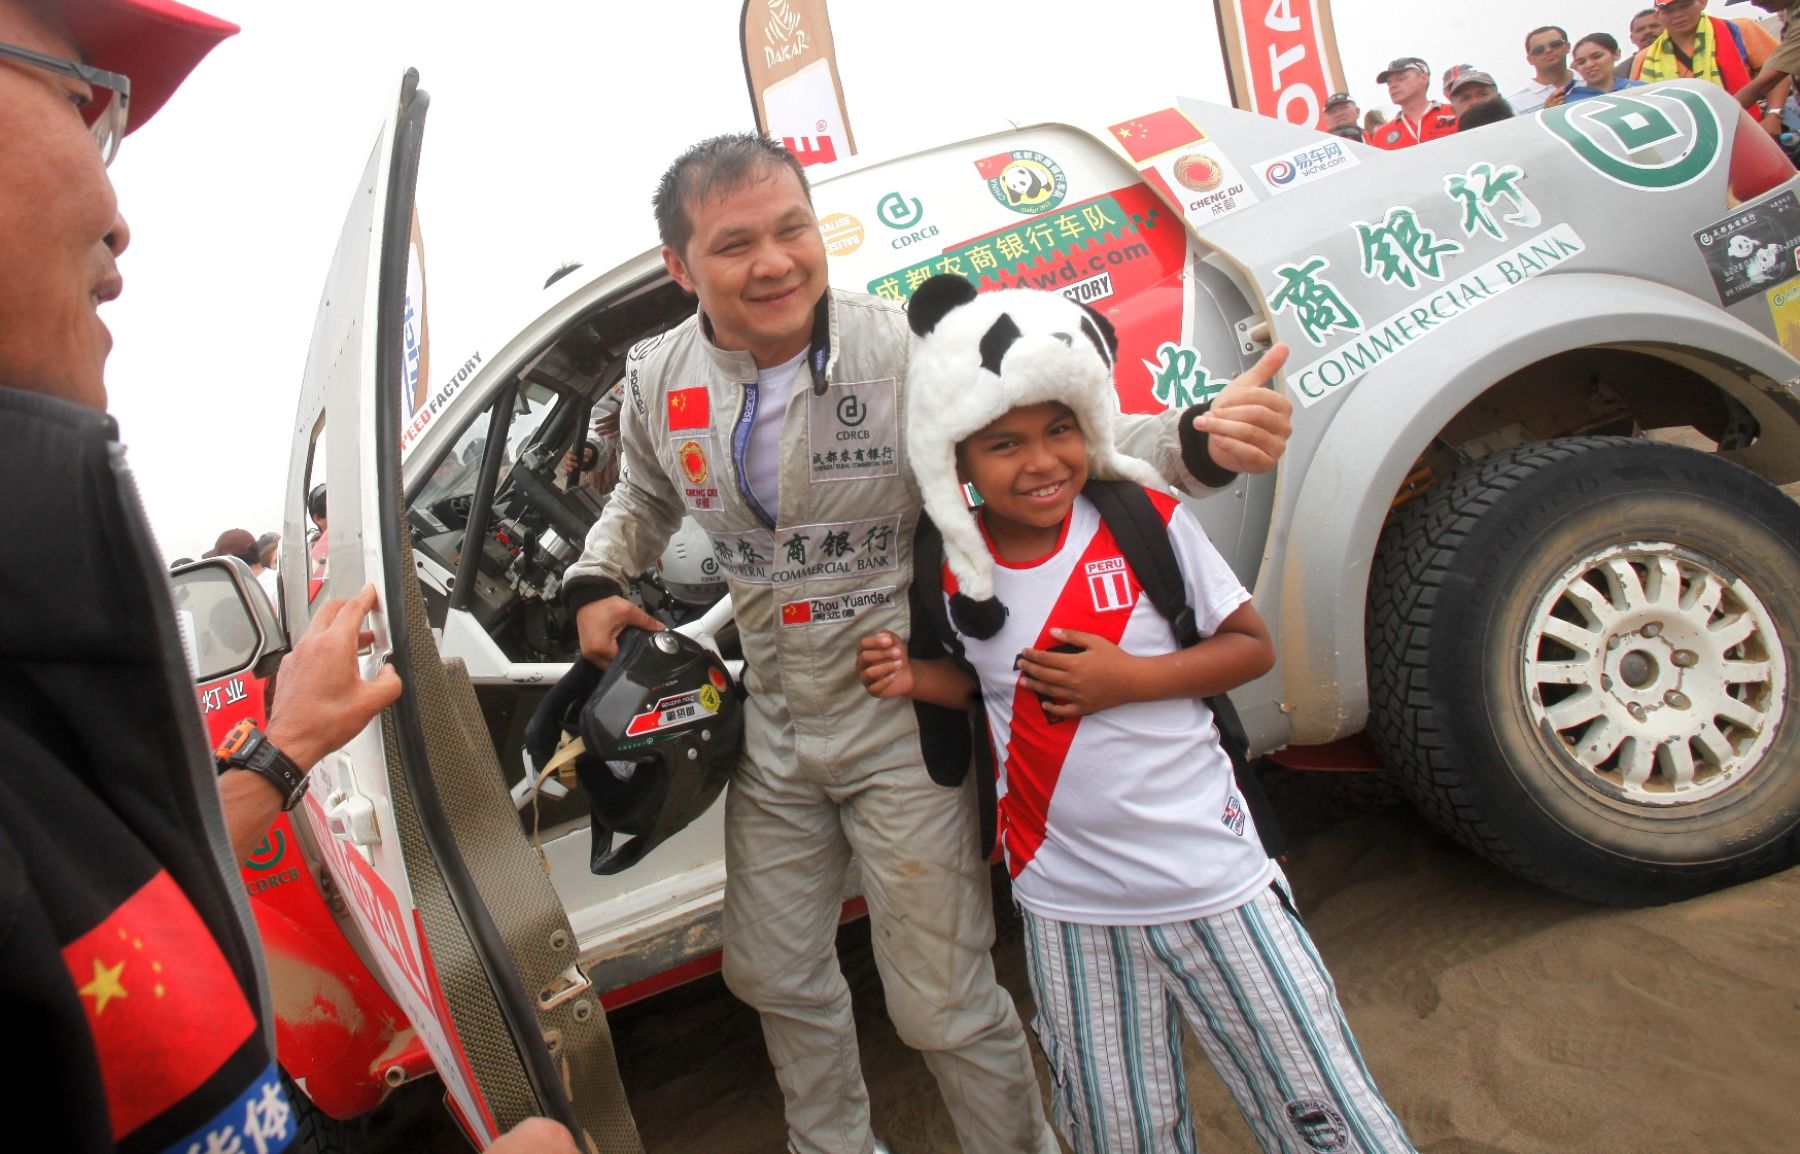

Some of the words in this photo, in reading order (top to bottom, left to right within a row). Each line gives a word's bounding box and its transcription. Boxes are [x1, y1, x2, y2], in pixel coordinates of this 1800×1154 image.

[764, 30, 809, 69] DAKAR
[1293, 142, 1344, 170] 易车网
[1301, 156, 1348, 177] yiche.com
[1189, 190, 1227, 212] CHENG
[1228, 183, 1244, 200] DU
[891, 224, 940, 250] CDRCB
[1001, 242, 1151, 292] 4wd.com
[1298, 275, 1499, 398] COMMERCIAL
[400, 408, 432, 451] PEED
[430, 351, 483, 415] FACTORY
[630, 368, 645, 415] sparco
[742, 388, 756, 423] sparco
[835, 430, 870, 442] CDRCB
[771, 561, 851, 584] COMMERCIAL
[857, 555, 889, 571] BANK
[1088, 558, 1123, 573] PERU
[811, 600, 839, 613] Zhou
[202, 678, 249, 713] 灯业
[246, 867, 300, 896] CDRCB
